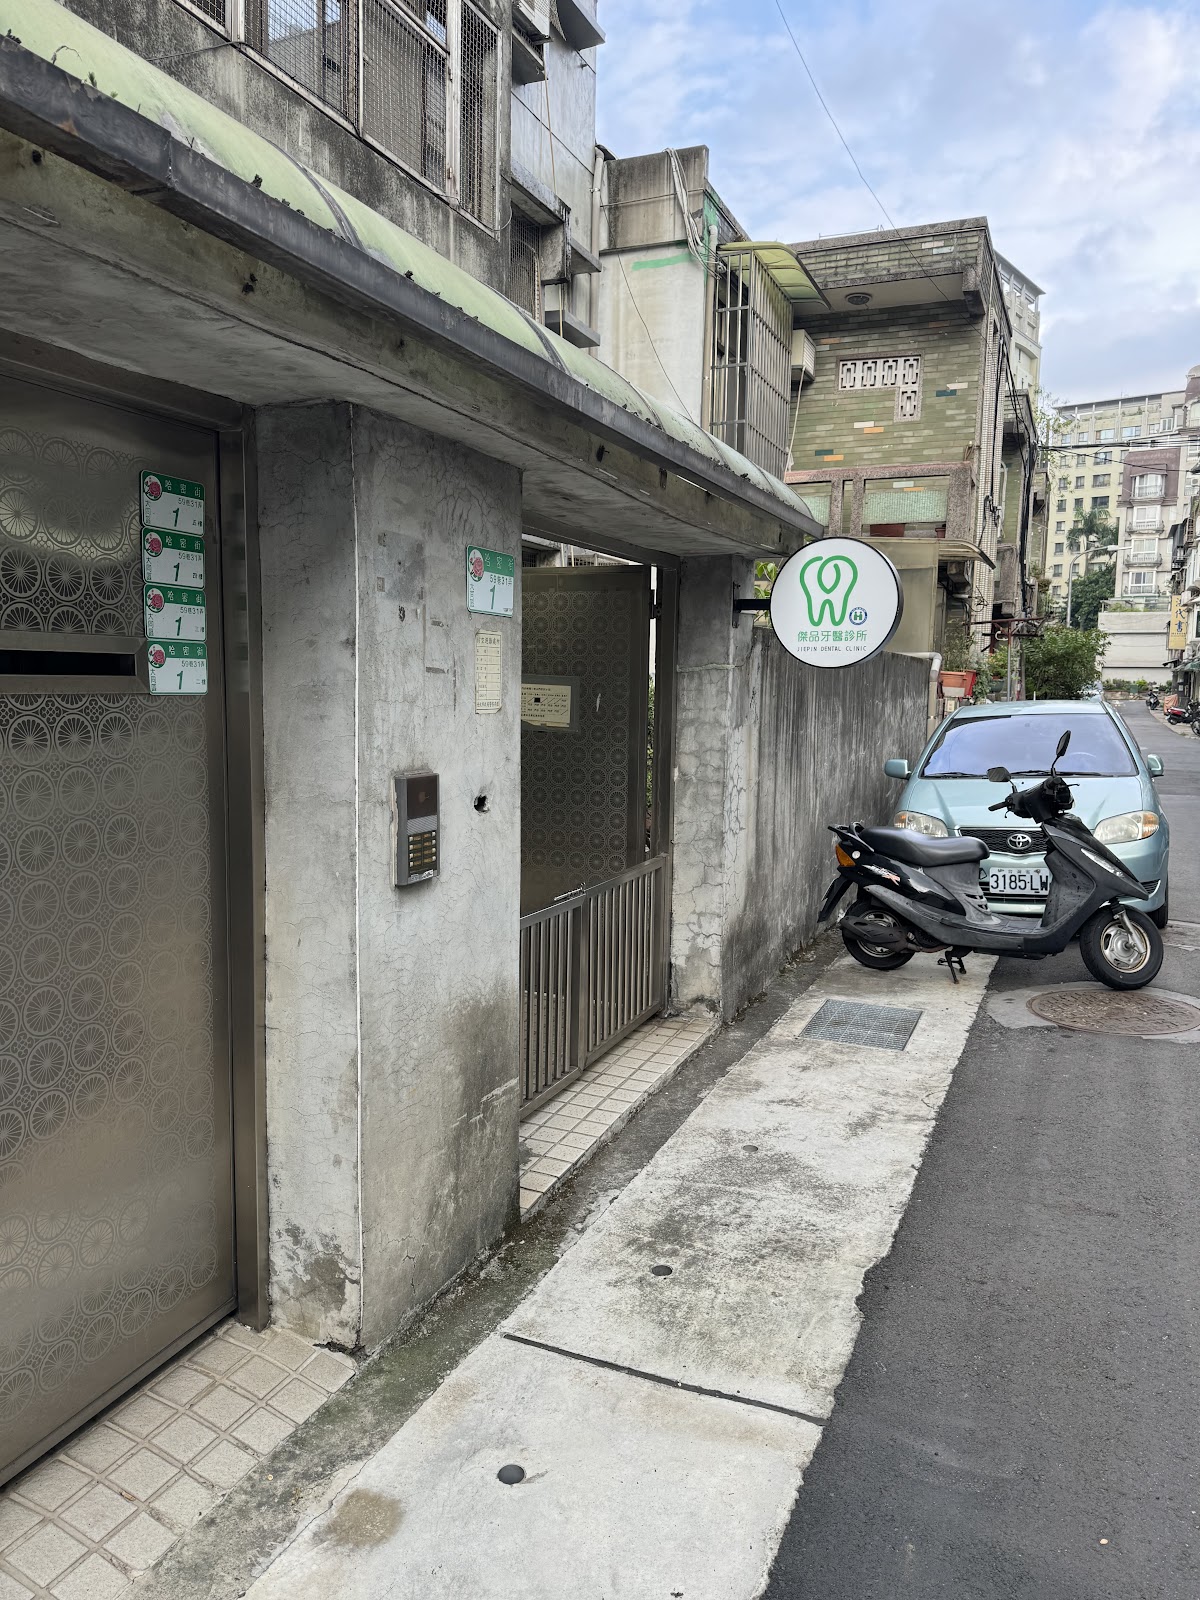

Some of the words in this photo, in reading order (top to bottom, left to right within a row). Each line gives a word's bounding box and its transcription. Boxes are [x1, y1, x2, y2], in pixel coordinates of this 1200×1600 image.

[164, 480, 201, 498] 哈密街
[172, 507, 180, 527] 1
[165, 535, 201, 550] 哈密街
[173, 562, 180, 582] 1
[167, 590, 202, 605] 哈密街
[489, 584, 496, 610] 1
[175, 616, 182, 636] 1
[797, 629, 868, 642] 傑品牙醫診所
[168, 645, 203, 657] 哈密街
[176, 670, 184, 690] 1
